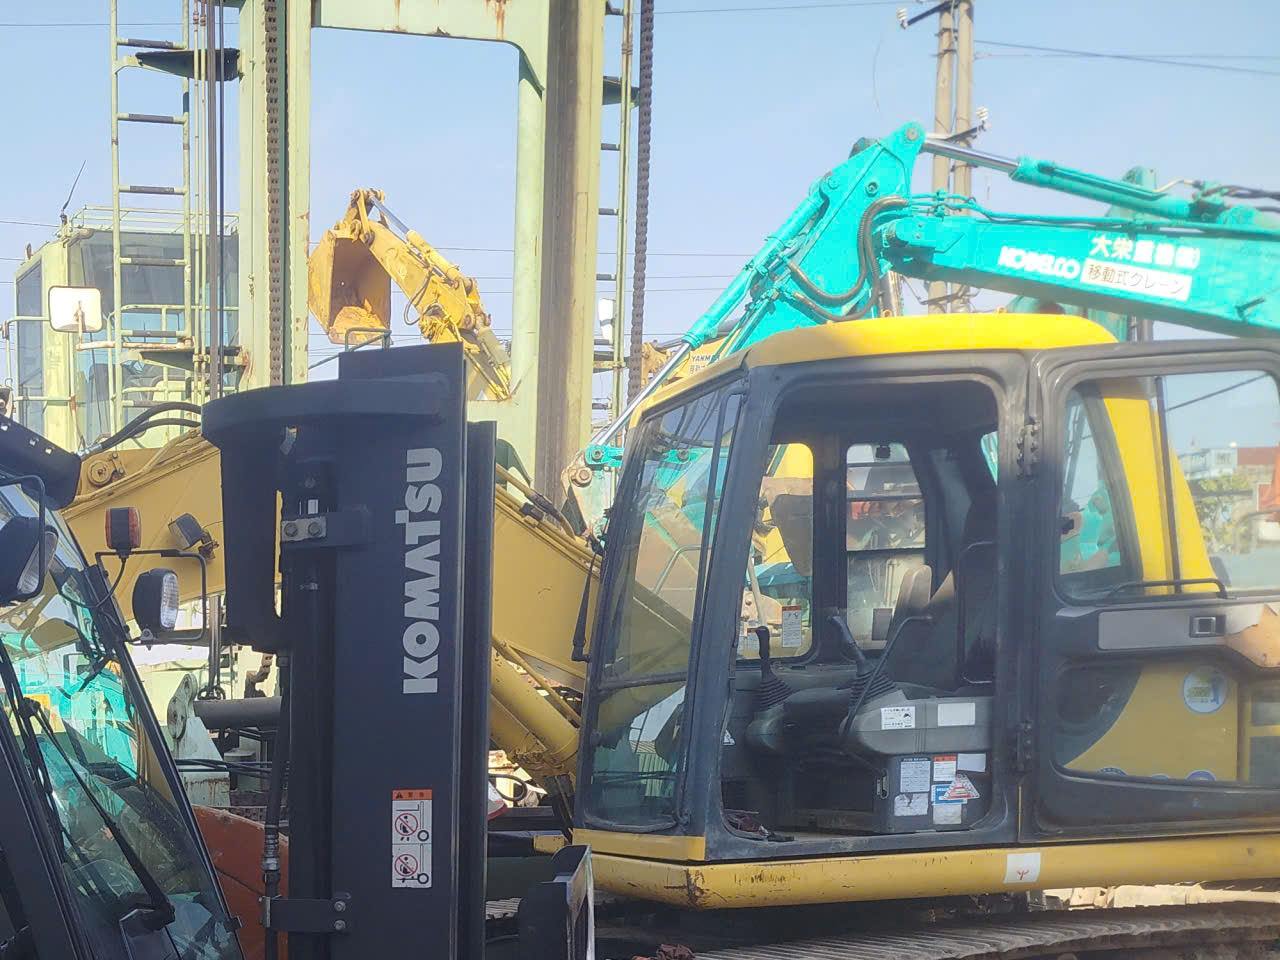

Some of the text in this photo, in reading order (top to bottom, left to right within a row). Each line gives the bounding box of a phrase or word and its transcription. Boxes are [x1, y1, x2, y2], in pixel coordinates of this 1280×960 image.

[998, 246, 1081, 278] KOBELCO
[1087, 263, 1185, 295] 移動式クレーン
[395, 447, 443, 694] KOMATSU
